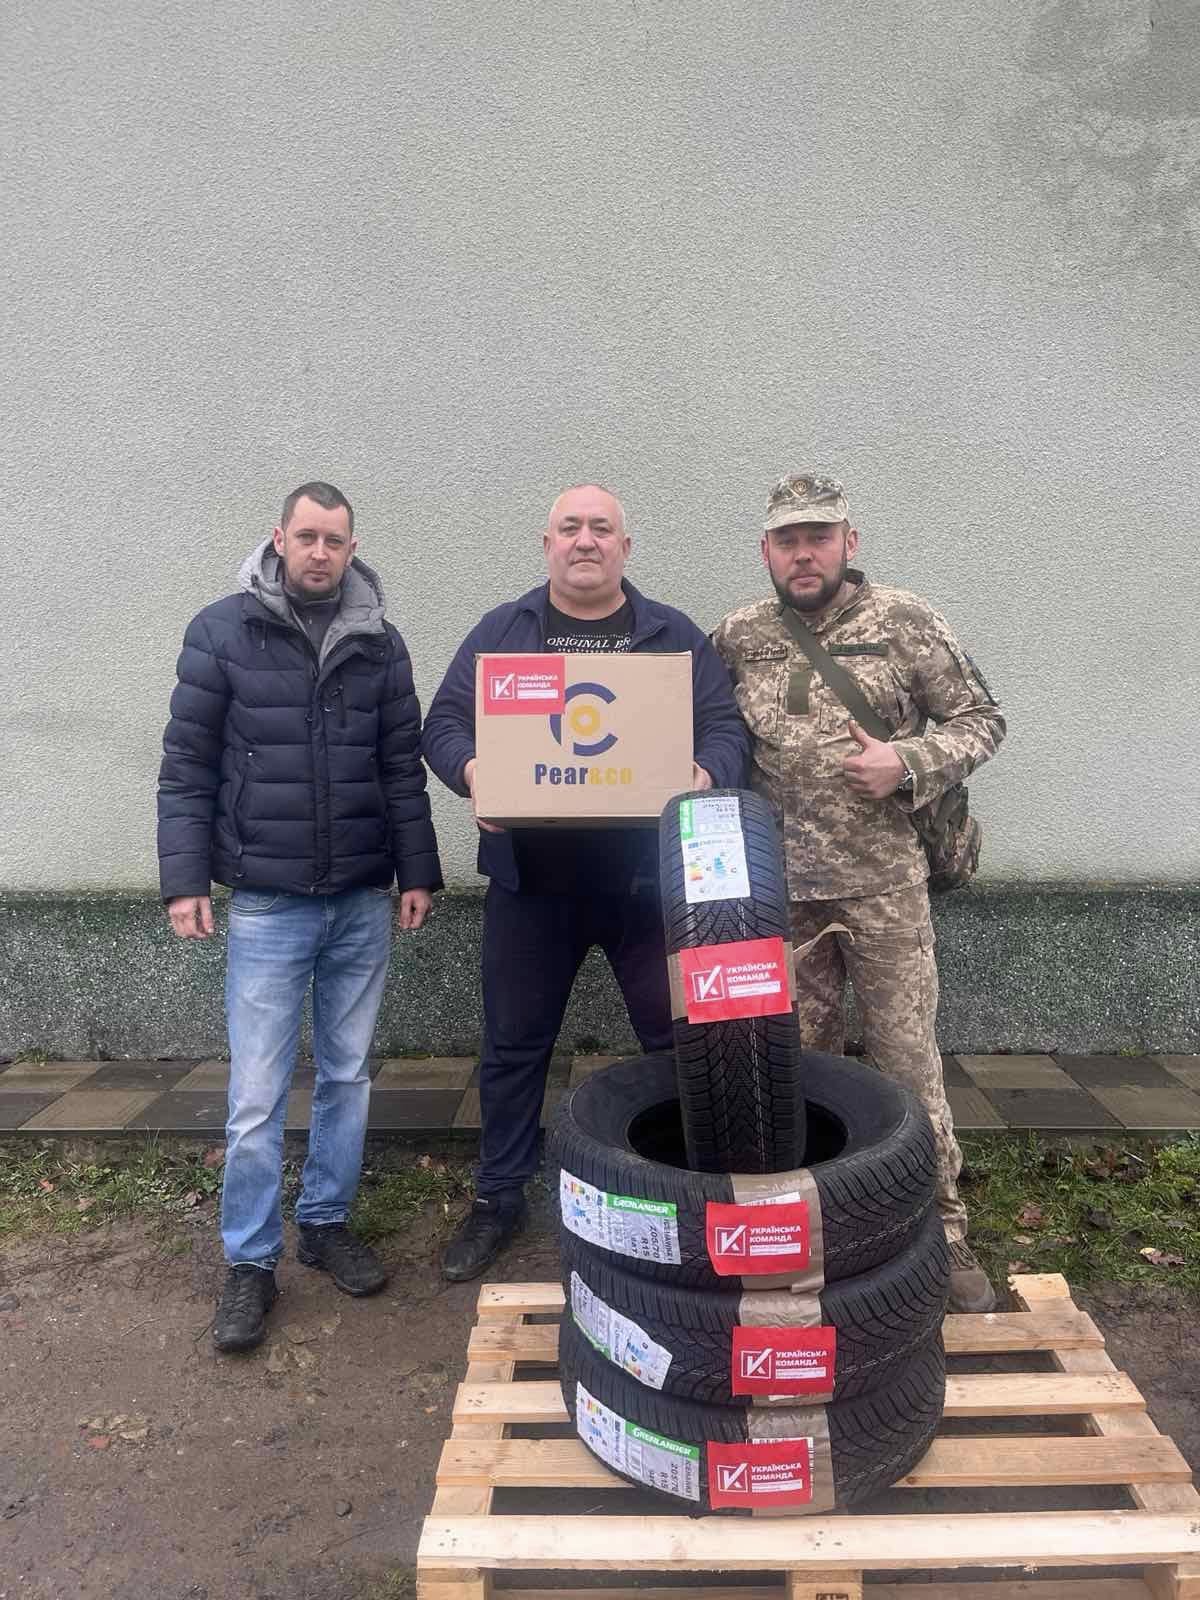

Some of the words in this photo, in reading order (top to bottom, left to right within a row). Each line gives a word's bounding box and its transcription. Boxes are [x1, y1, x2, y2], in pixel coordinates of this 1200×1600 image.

[546, 637, 610, 649] ORIGINAL
[726, 962, 778, 974] УКРАЇНСЬКА
[727, 974, 771, 984] КОМАНДА
[750, 1225, 802, 1234] УКРАЇНСЬКА
[649, 1225, 660, 1259] 205/70
[749, 1234, 792, 1243] КОМАНДА
[641, 1238, 650, 1256] R15
[776, 1350, 827, 1358] УКРАЇНСЬКА
[776, 1359, 817, 1367] КОМАНДА
[751, 1462, 802, 1473] УКРАЇНСЬКА
[660, 1472, 668, 1489] R15
[671, 1463, 679, 1493] 205/70
[751, 1472, 793, 1481] КОМАНДА
